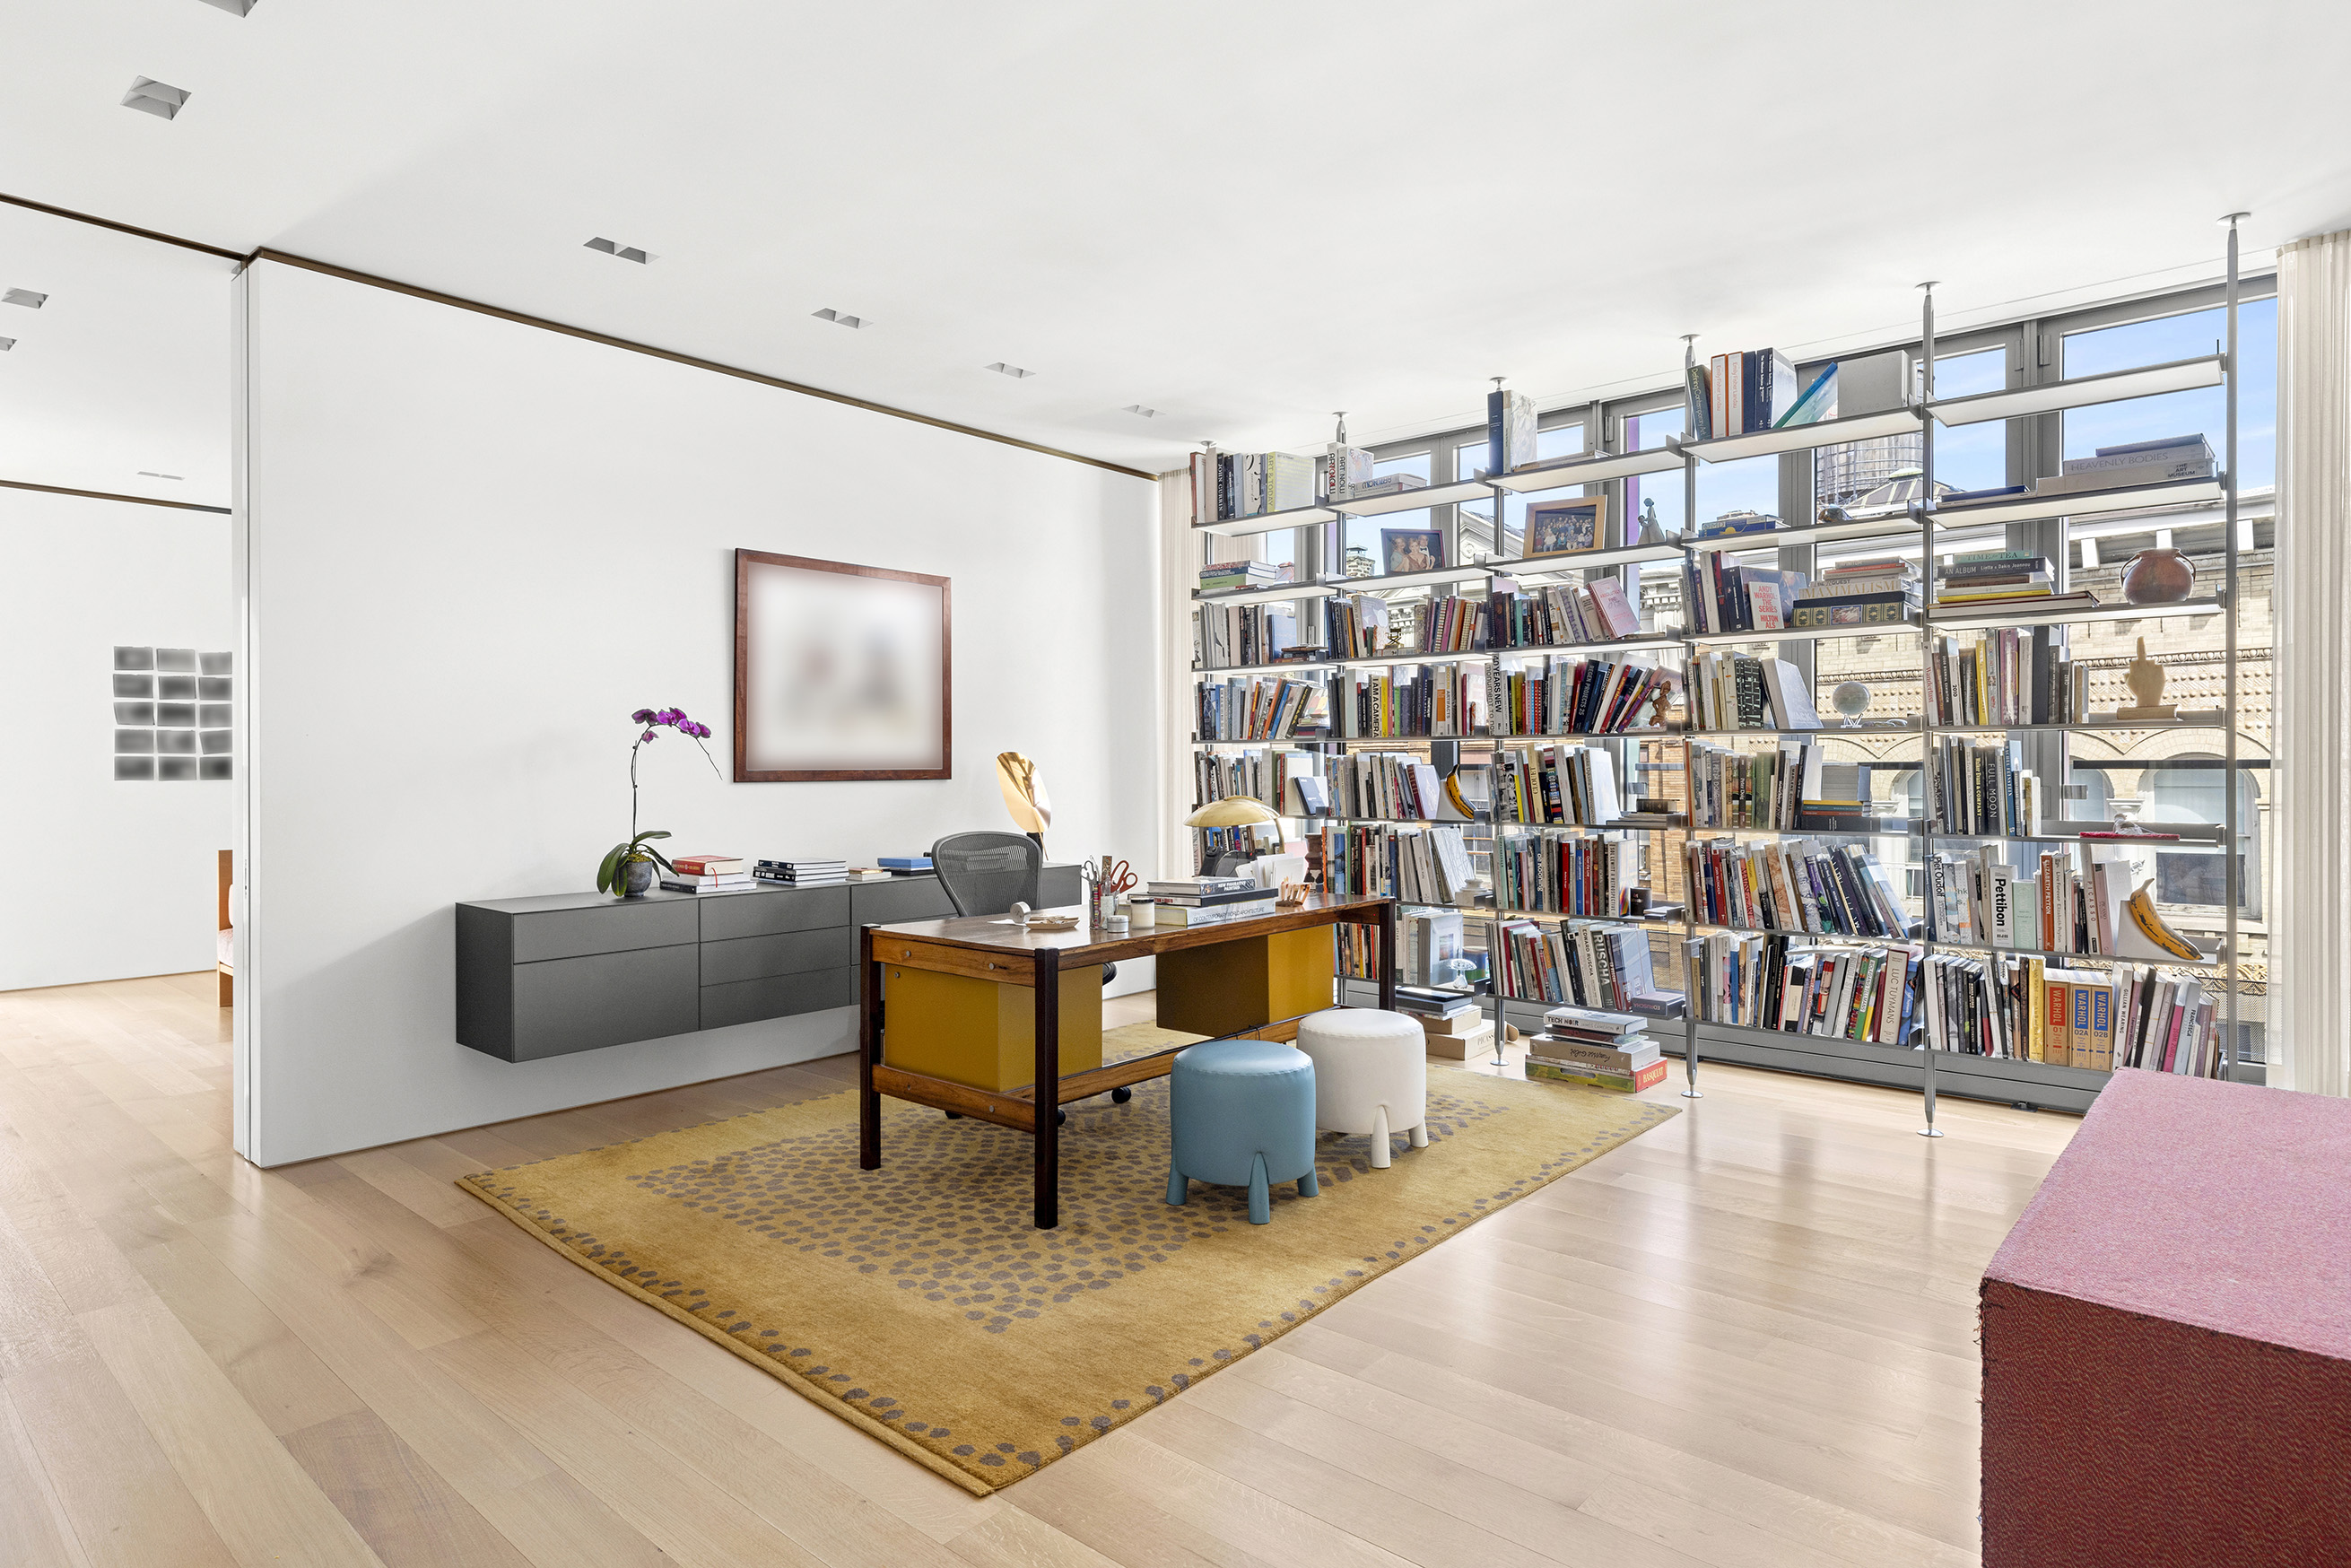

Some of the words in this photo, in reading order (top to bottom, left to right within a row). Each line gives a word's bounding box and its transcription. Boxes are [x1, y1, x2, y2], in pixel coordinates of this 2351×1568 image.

[1692, 368, 1702, 390] Defining
[1694, 389, 1706, 427] Contemporary
[2070, 457, 2125, 472] HEAVENLY
[2129, 451, 2169, 465] BODIES
[2167, 470, 2196, 478] MUSEUM
[1966, 553, 1990, 562] TIME
[1999, 551, 2018, 559] TEA
[1955, 566, 1976, 575] ALBUM
[1805, 581, 1895, 598] MAXIMALISM
[1758, 605, 1778, 613] SERIES
[1585, 666, 1595, 682] REGEN
[1926, 666, 1934, 703] Wanderlust
[1373, 683, 1379, 695] AM
[1580, 683, 1592, 708] PROJECTS
[1529, 767, 1538, 795] CLOUET
[1989, 788, 1997, 818] MOON
[1933, 856, 1943, 870] Piet
[1741, 867, 1751, 894] MATISSE
[1935, 872, 1946, 897] Oudolf
[1995, 878, 2007, 927] Pettibon
[2087, 881, 2096, 922] PICASSO
[1582, 929, 1590, 952] EDWARD
[1586, 953, 1594, 976] RUSCHA
[1593, 934, 1610, 986] RUSCHA
[1865, 961, 1875, 987] WOLFGANG
[1890, 968, 1899, 985] LUC
[1860, 987, 1869, 1011] TILLMANS
[1886, 986, 1898, 1024] TUYMANS
[2052, 989, 2062, 1024] WARHOL
[2077, 992, 2087, 1026] WARHOL
[2096, 994, 2107, 1028] WARHOL
[1547, 1015, 1563, 1024] TECH
[2187, 1009, 2196, 1037] FRANCESCA
[1642, 1067, 1664, 1083] BASQUIAT
